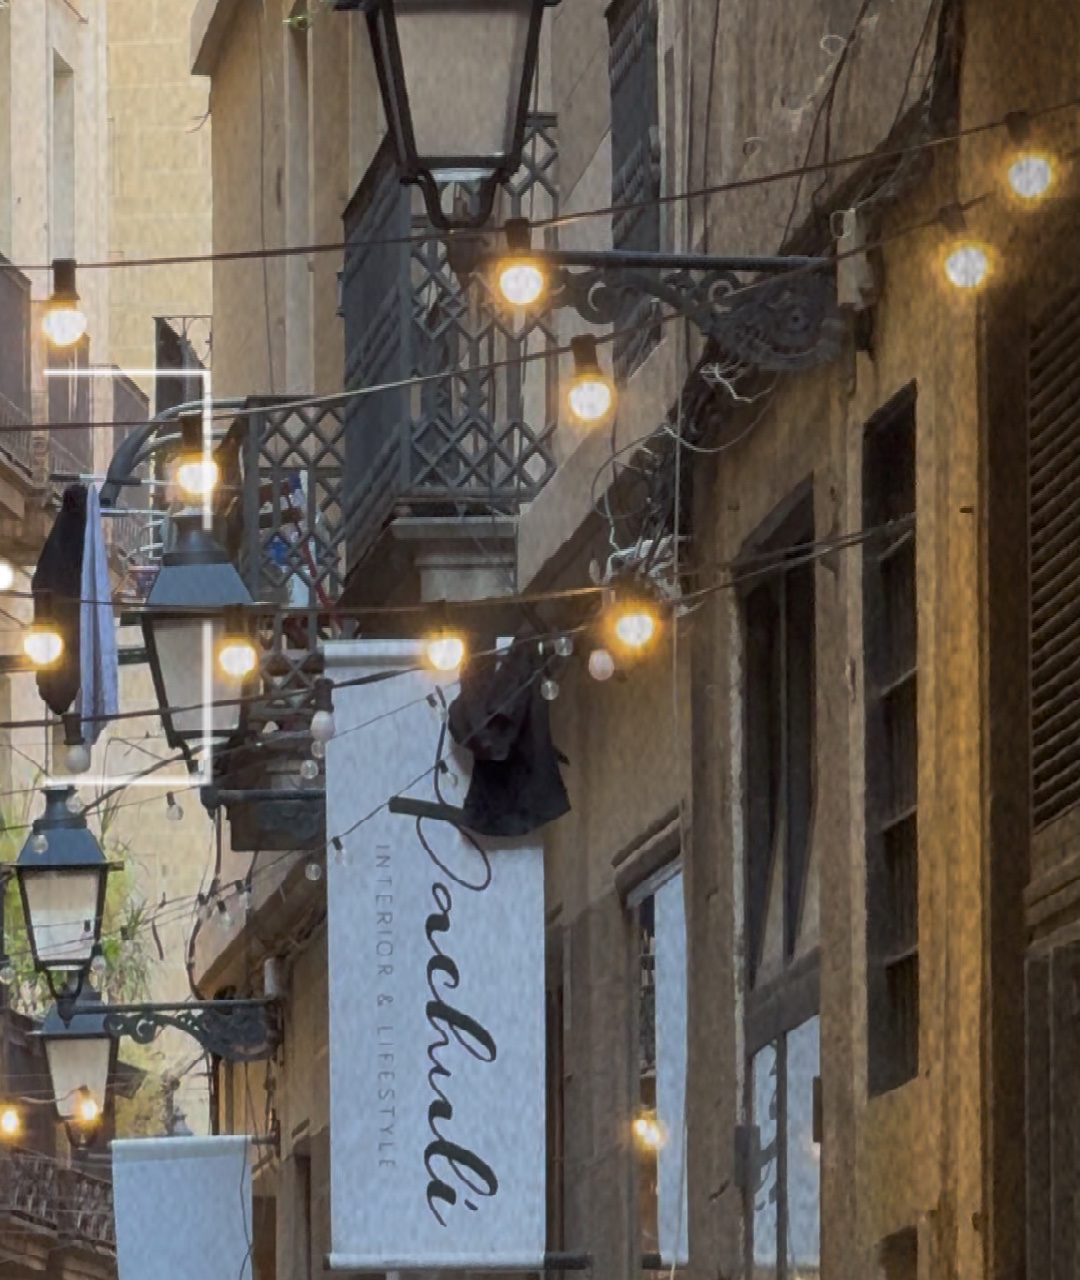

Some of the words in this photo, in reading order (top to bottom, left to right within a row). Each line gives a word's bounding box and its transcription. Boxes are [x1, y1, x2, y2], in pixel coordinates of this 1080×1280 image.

[376, 845, 394, 976] INTERIOR
[376, 994, 394, 1008] &
[377, 1025, 396, 1168] LIFESTYLE
